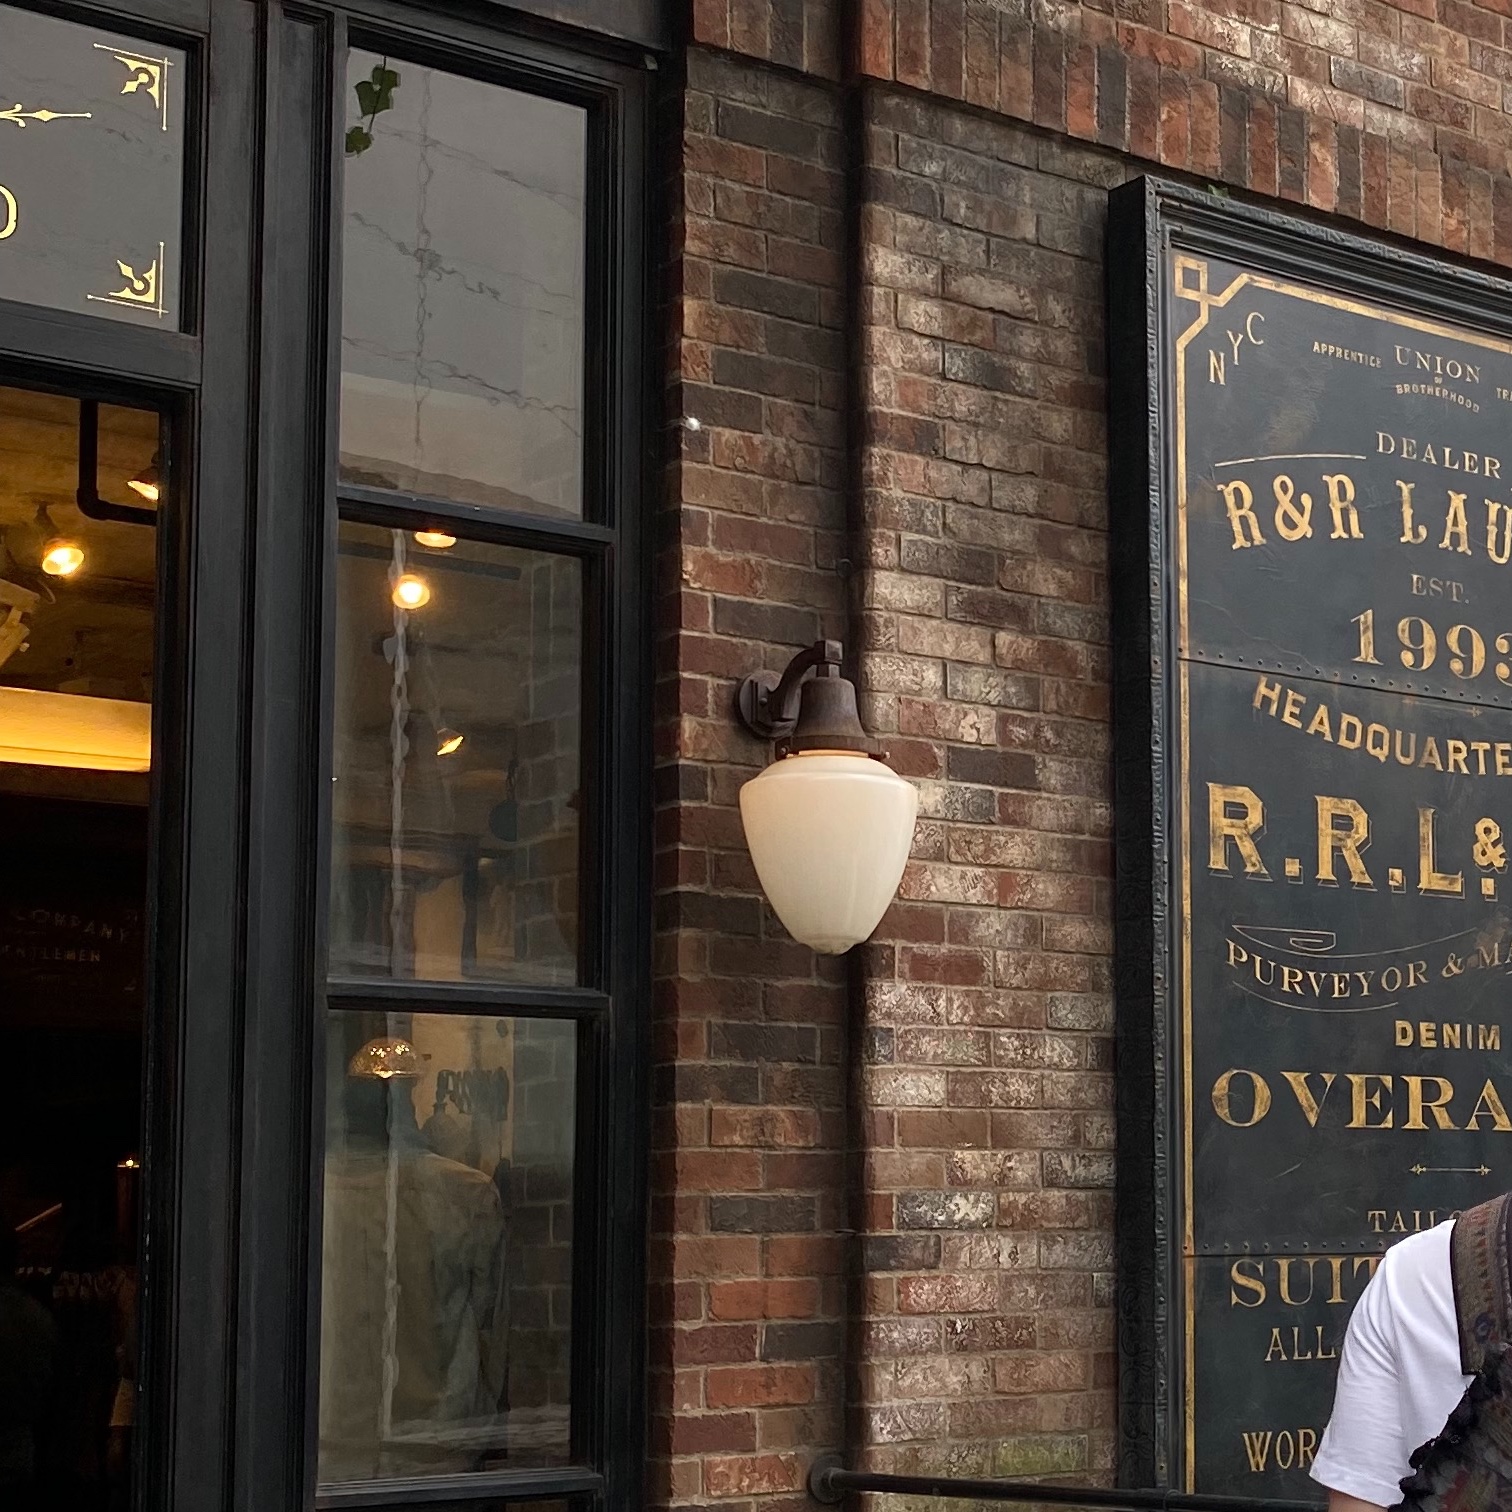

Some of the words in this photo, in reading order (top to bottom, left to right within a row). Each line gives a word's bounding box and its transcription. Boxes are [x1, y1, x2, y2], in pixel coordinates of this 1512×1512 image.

[1209, 311, 1266, 387] NYC
[1312, 341, 1382, 369] APPRENTICE
[1394, 345, 1482, 384] UNION
[1395, 384, 1480, 413] BROTHERHOOD
[1376, 431, 1503, 480] DEALER
[1216, 473, 1365, 551] R&R
[1410, 573, 1470, 604] EST.
[1225, 938, 1428, 1000] PURVEYOR
[1441, 952, 1465, 978] &
[1394, 1020, 1501, 1051] DENIM
[1264, 1326, 1337, 1362] ALL
[1242, 1428, 1325, 1472] WOR
